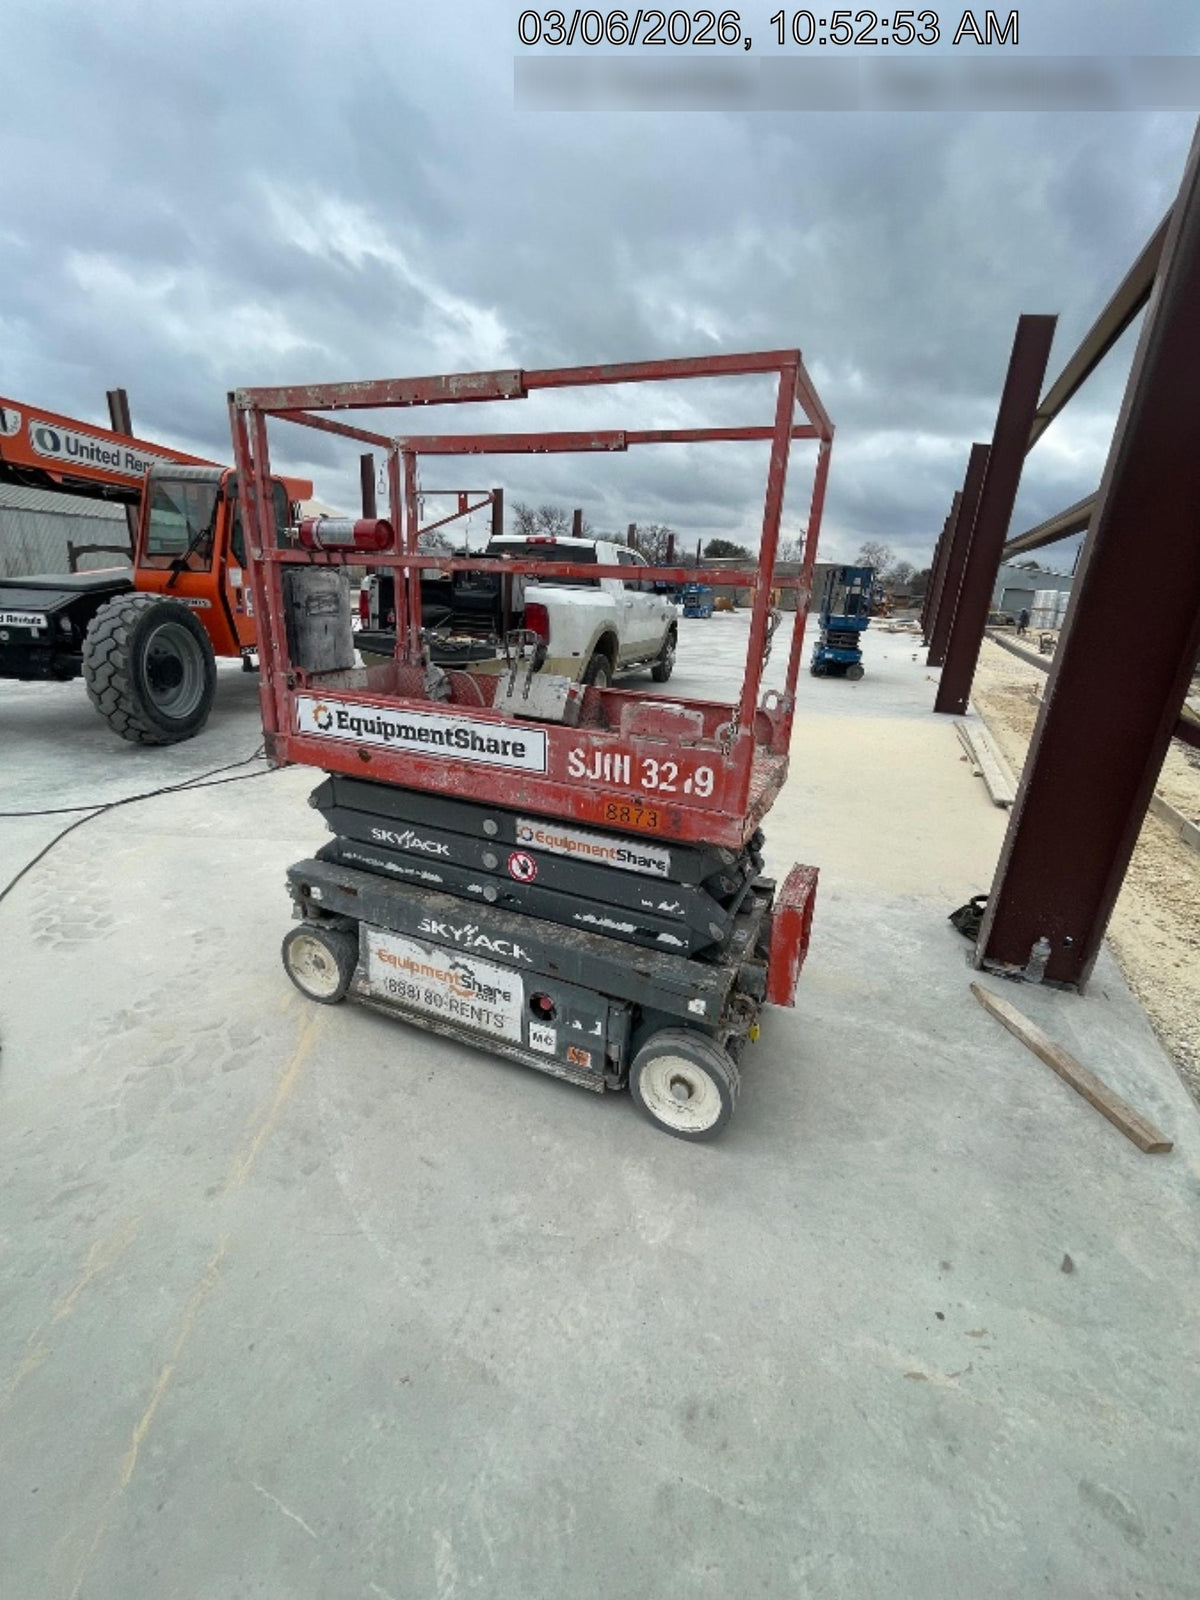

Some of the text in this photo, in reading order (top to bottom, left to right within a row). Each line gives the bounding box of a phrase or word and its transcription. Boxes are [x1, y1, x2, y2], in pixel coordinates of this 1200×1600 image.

[65, 435, 120, 466] United
[335, 710, 526, 758] EquipmentShare
[605, 803, 657, 828] 8873
[371, 828, 450, 856] SKYJACK
[535, 830, 666, 871] EquipmentShare
[416, 919, 533, 962] SKYJACK
[377, 948, 511, 1001] EquipmentShare
